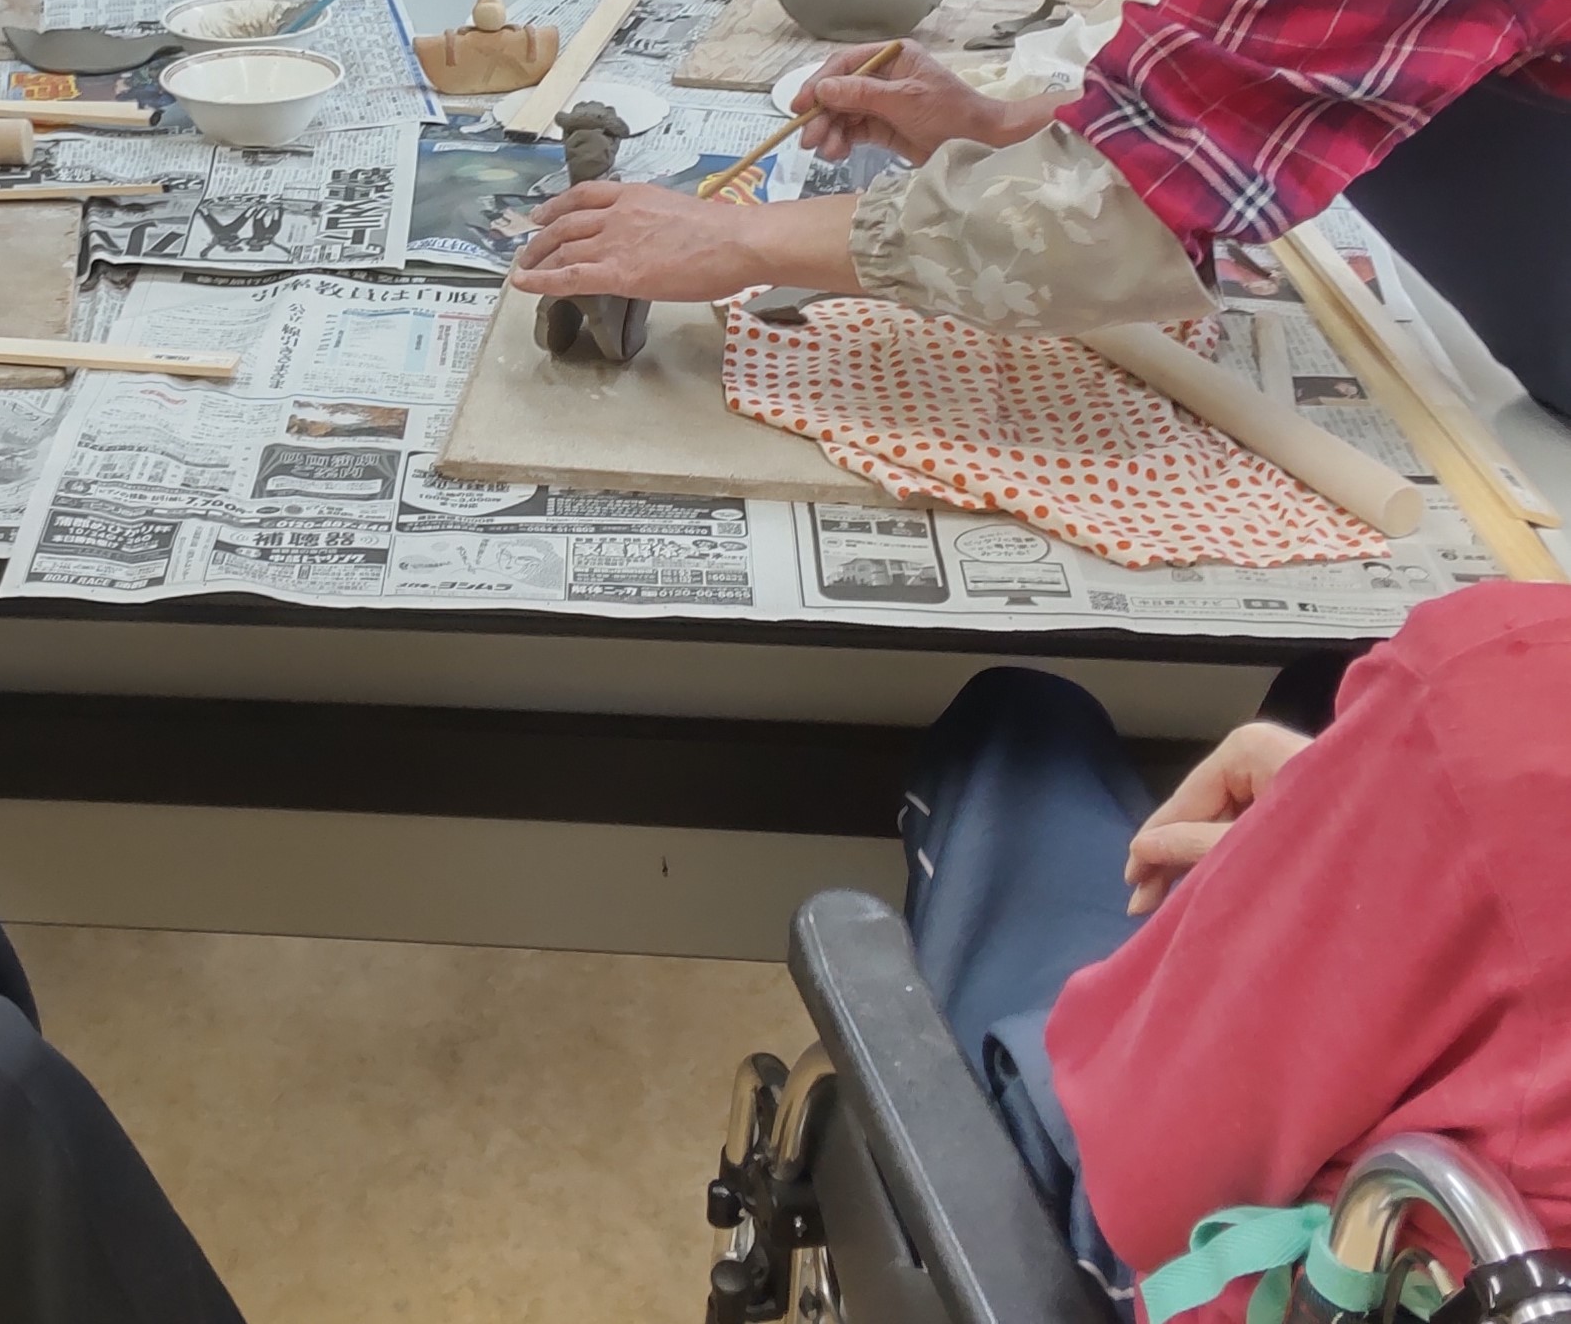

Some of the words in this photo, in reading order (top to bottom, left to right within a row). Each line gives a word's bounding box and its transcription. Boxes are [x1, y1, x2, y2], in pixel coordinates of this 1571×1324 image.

[252, 532, 355, 546] 補聴器
[42, 573, 77, 583] BOAT
[76, 576, 111, 586] RACE
